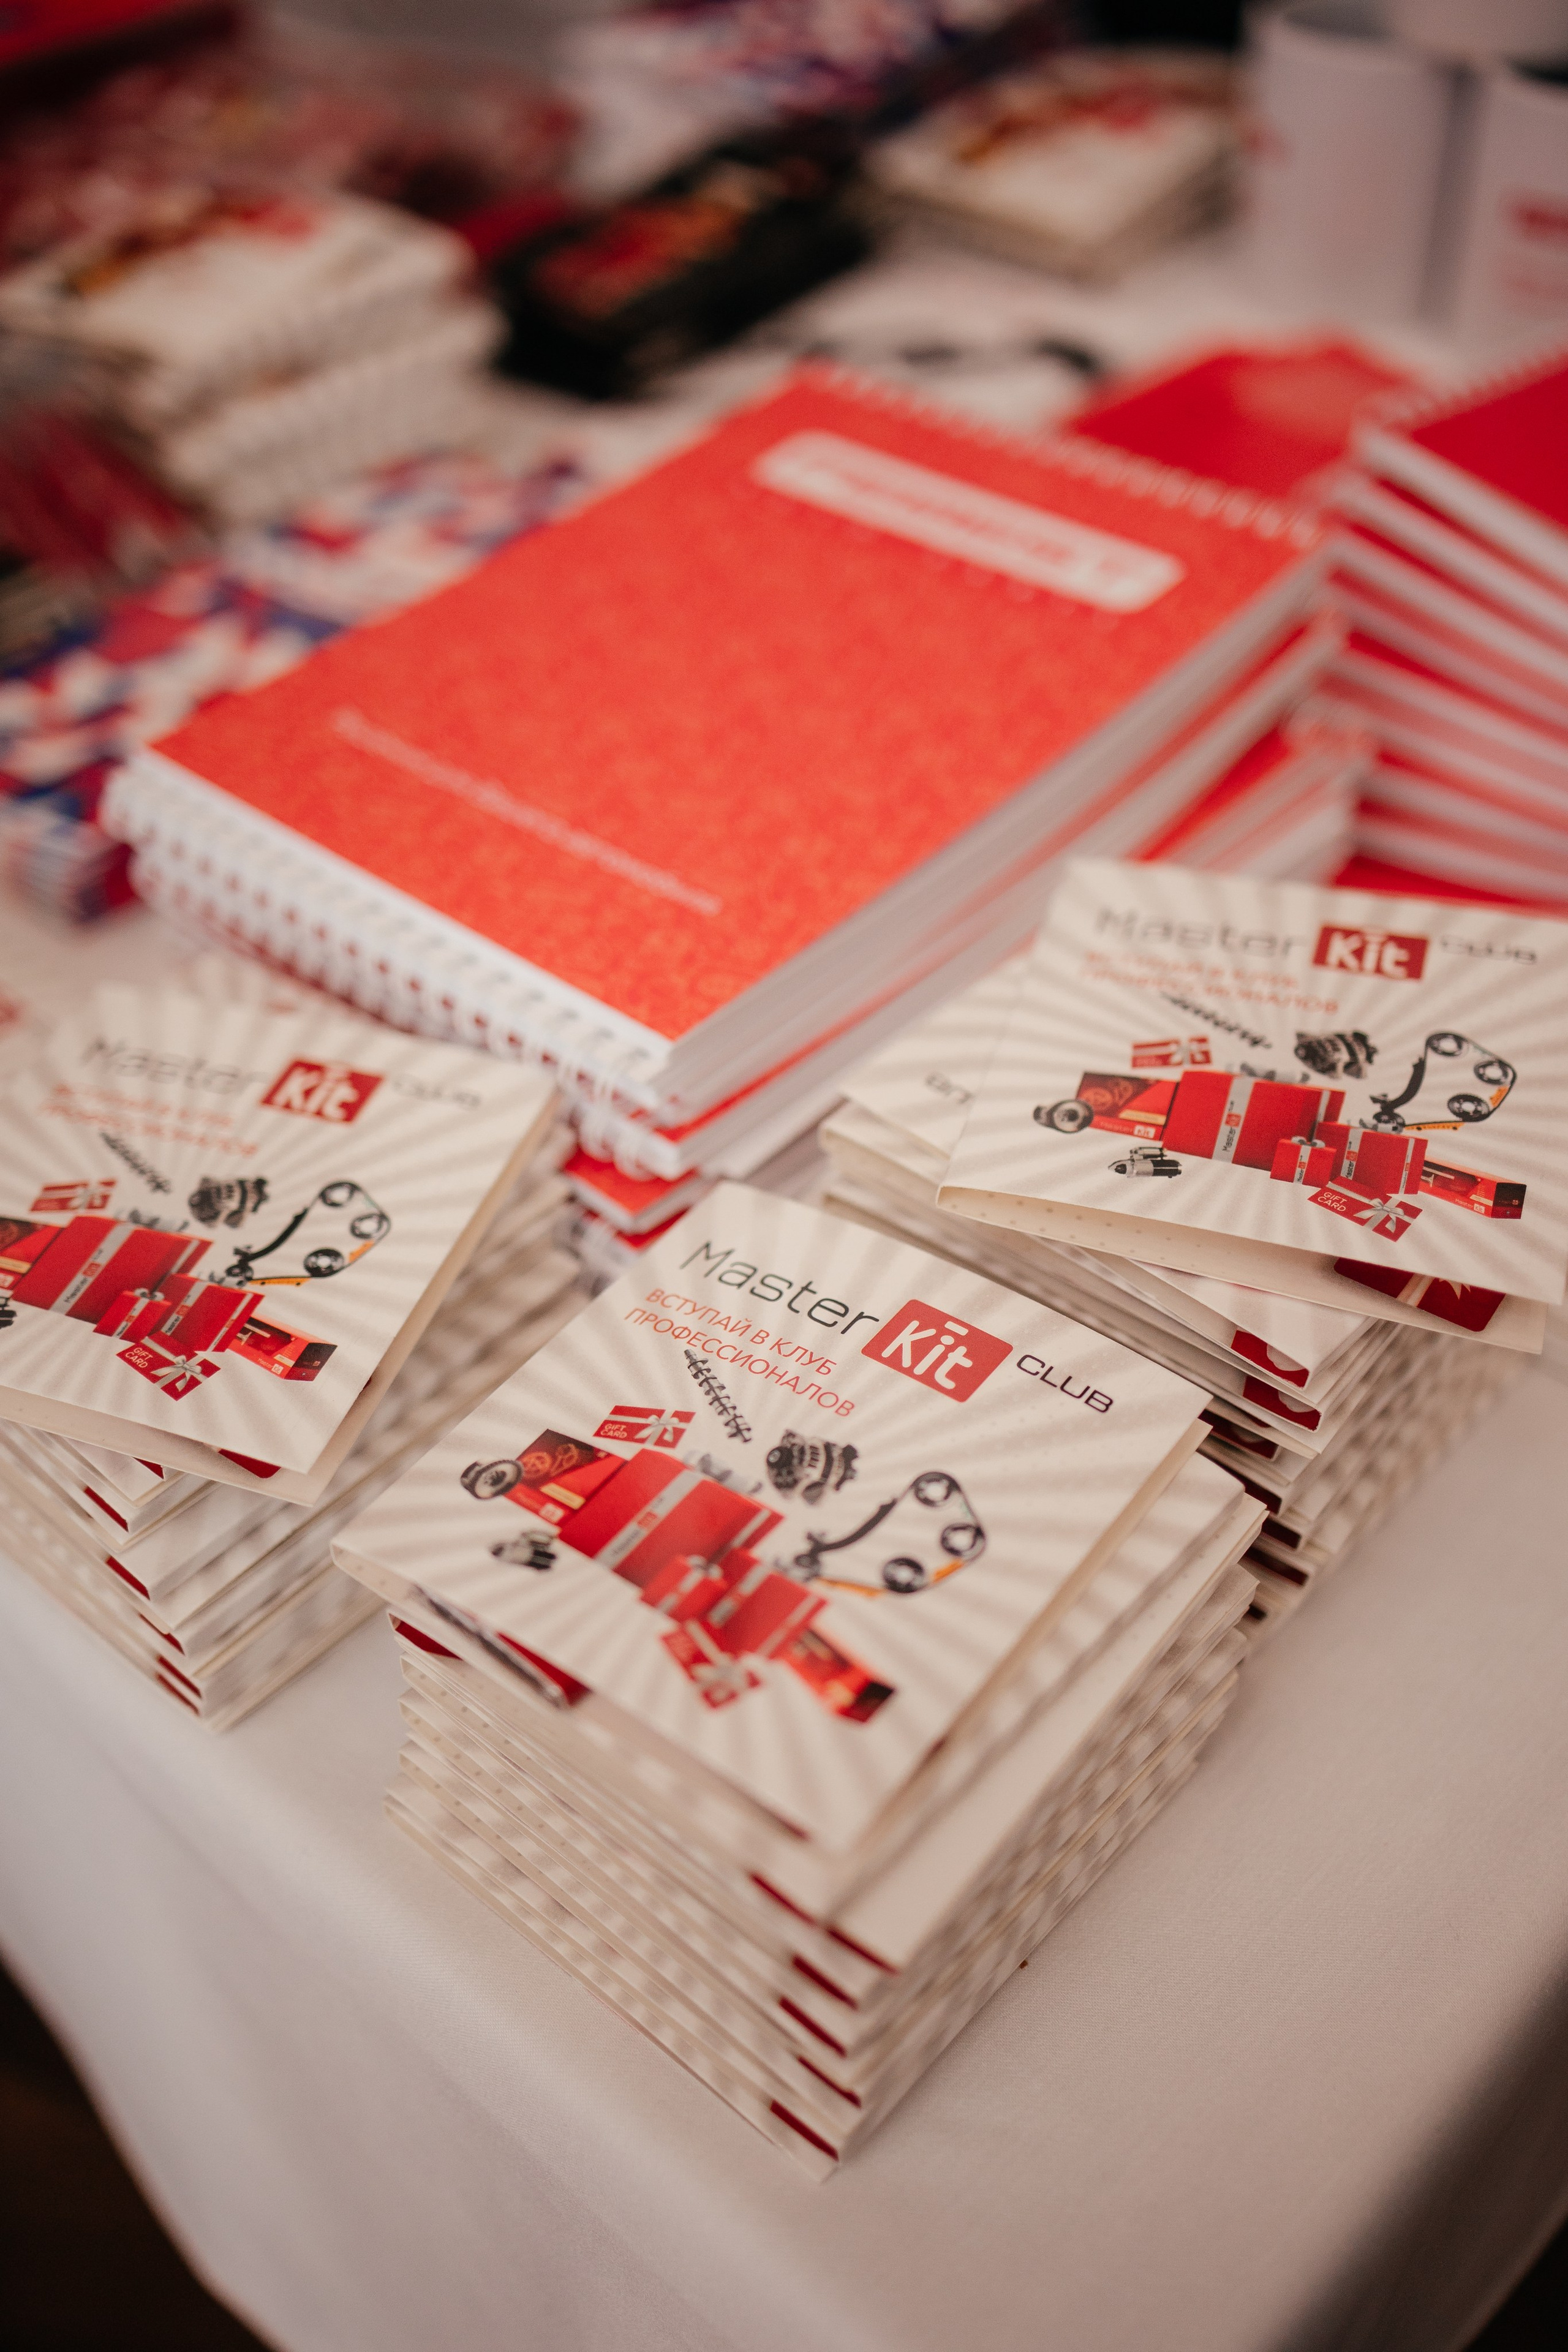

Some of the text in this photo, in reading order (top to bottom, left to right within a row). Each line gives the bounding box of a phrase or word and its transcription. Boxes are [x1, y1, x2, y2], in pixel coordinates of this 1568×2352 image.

[1327, 927, 1410, 979] Kit
[273, 1063, 356, 1122] Kit
[1317, 1196, 1346, 1212] CARD
[1324, 1192, 1348, 1204] GIFT
[645, 1288, 837, 1376] ВСТУПАЙ В КЛУБ
[679, 1240, 1114, 1413] Master Kit CLUB
[125, 1351, 148, 1368] CARD
[134, 1348, 153, 1360] GIFT
[624, 1308, 856, 1417] ПРОФЕССИОНАЛОВ
[600, 1429, 628, 1439] CARD
[605, 1423, 627, 1432] GIFT
